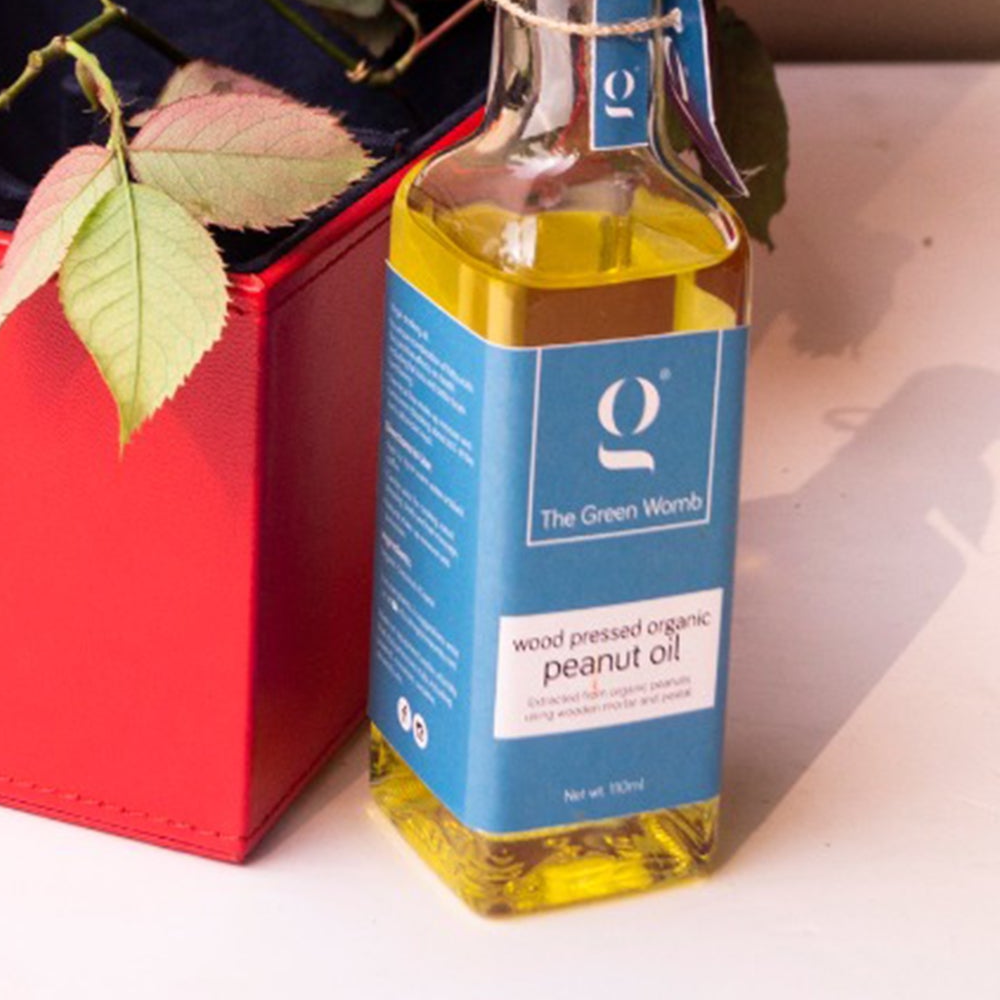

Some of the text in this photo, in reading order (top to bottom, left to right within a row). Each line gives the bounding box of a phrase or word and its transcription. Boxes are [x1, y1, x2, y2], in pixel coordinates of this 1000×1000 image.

[541, 491, 704, 531] The Green Womb
[512, 609, 712, 652] wood pressed organic
[543, 633, 681, 687] peanut oil
